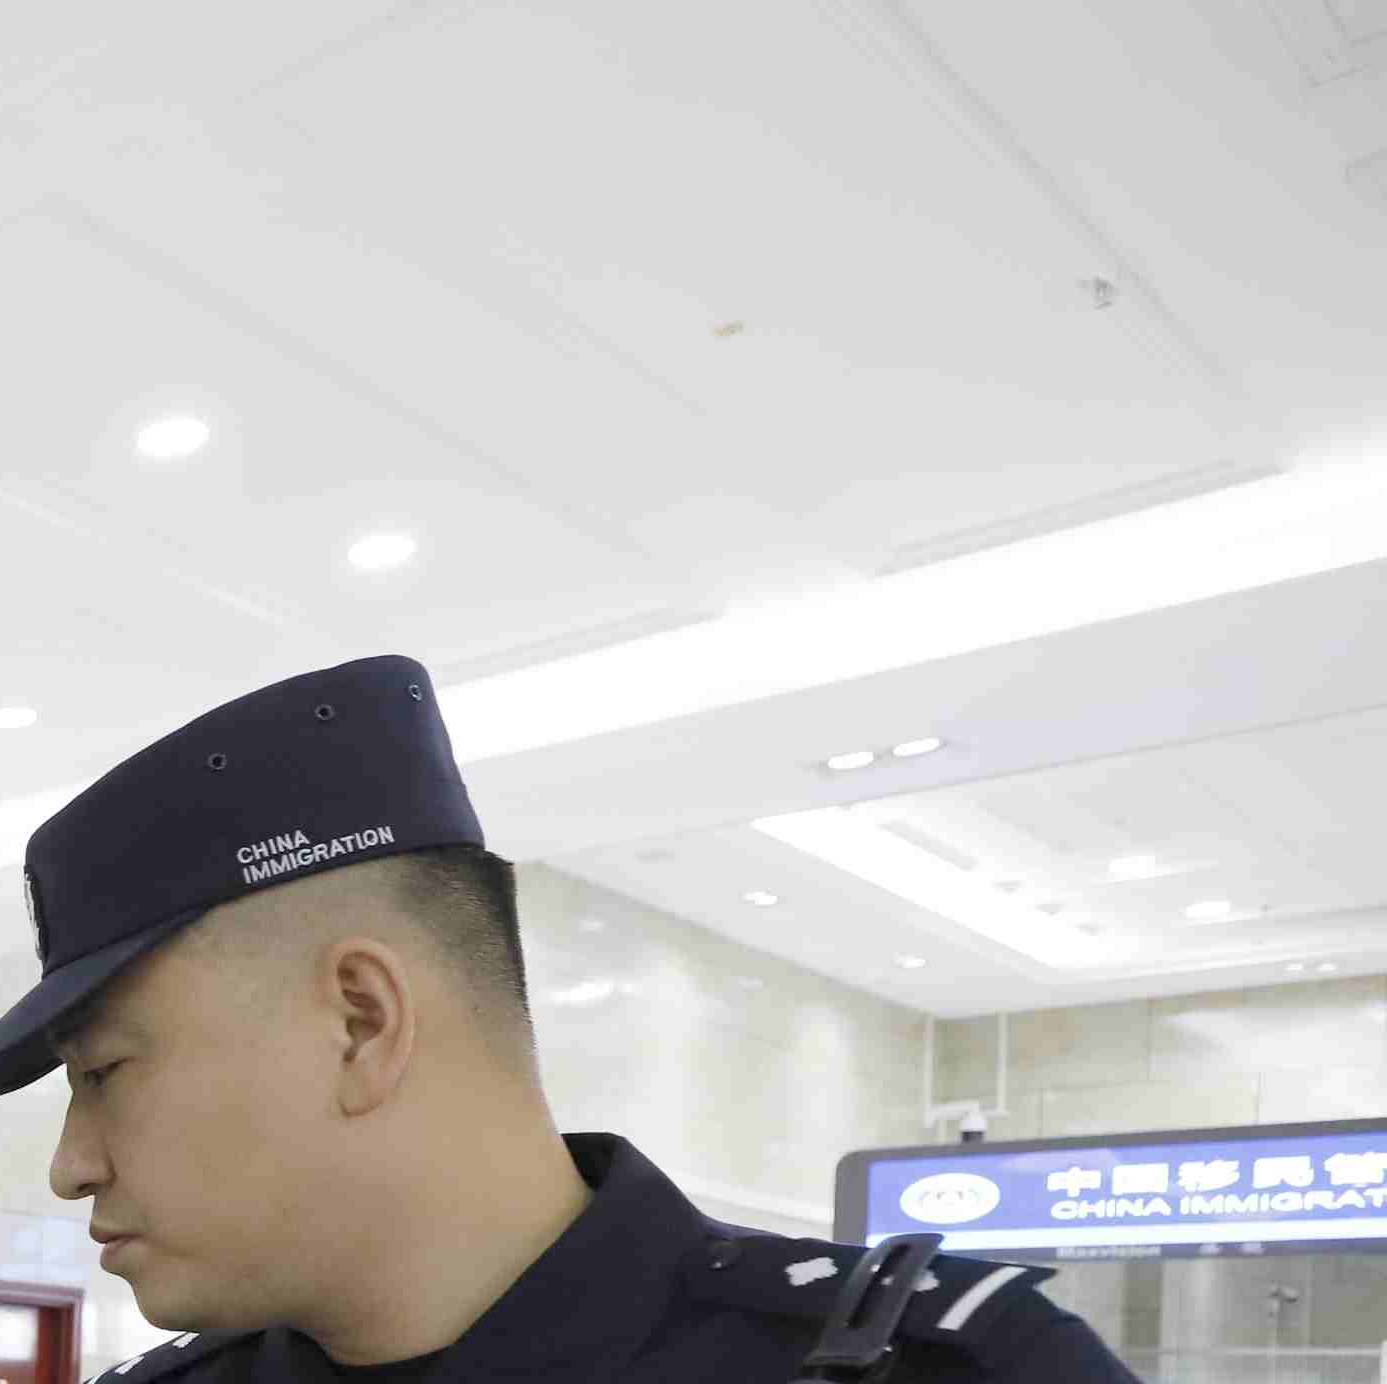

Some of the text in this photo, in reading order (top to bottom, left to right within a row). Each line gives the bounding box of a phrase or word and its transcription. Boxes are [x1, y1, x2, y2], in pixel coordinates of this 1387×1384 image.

[237, 830, 310, 864] CHINA
[243, 826, 395, 884] IMMIGRATION
[1051, 1187, 1387, 1220] CHINA IMMIGRAT
